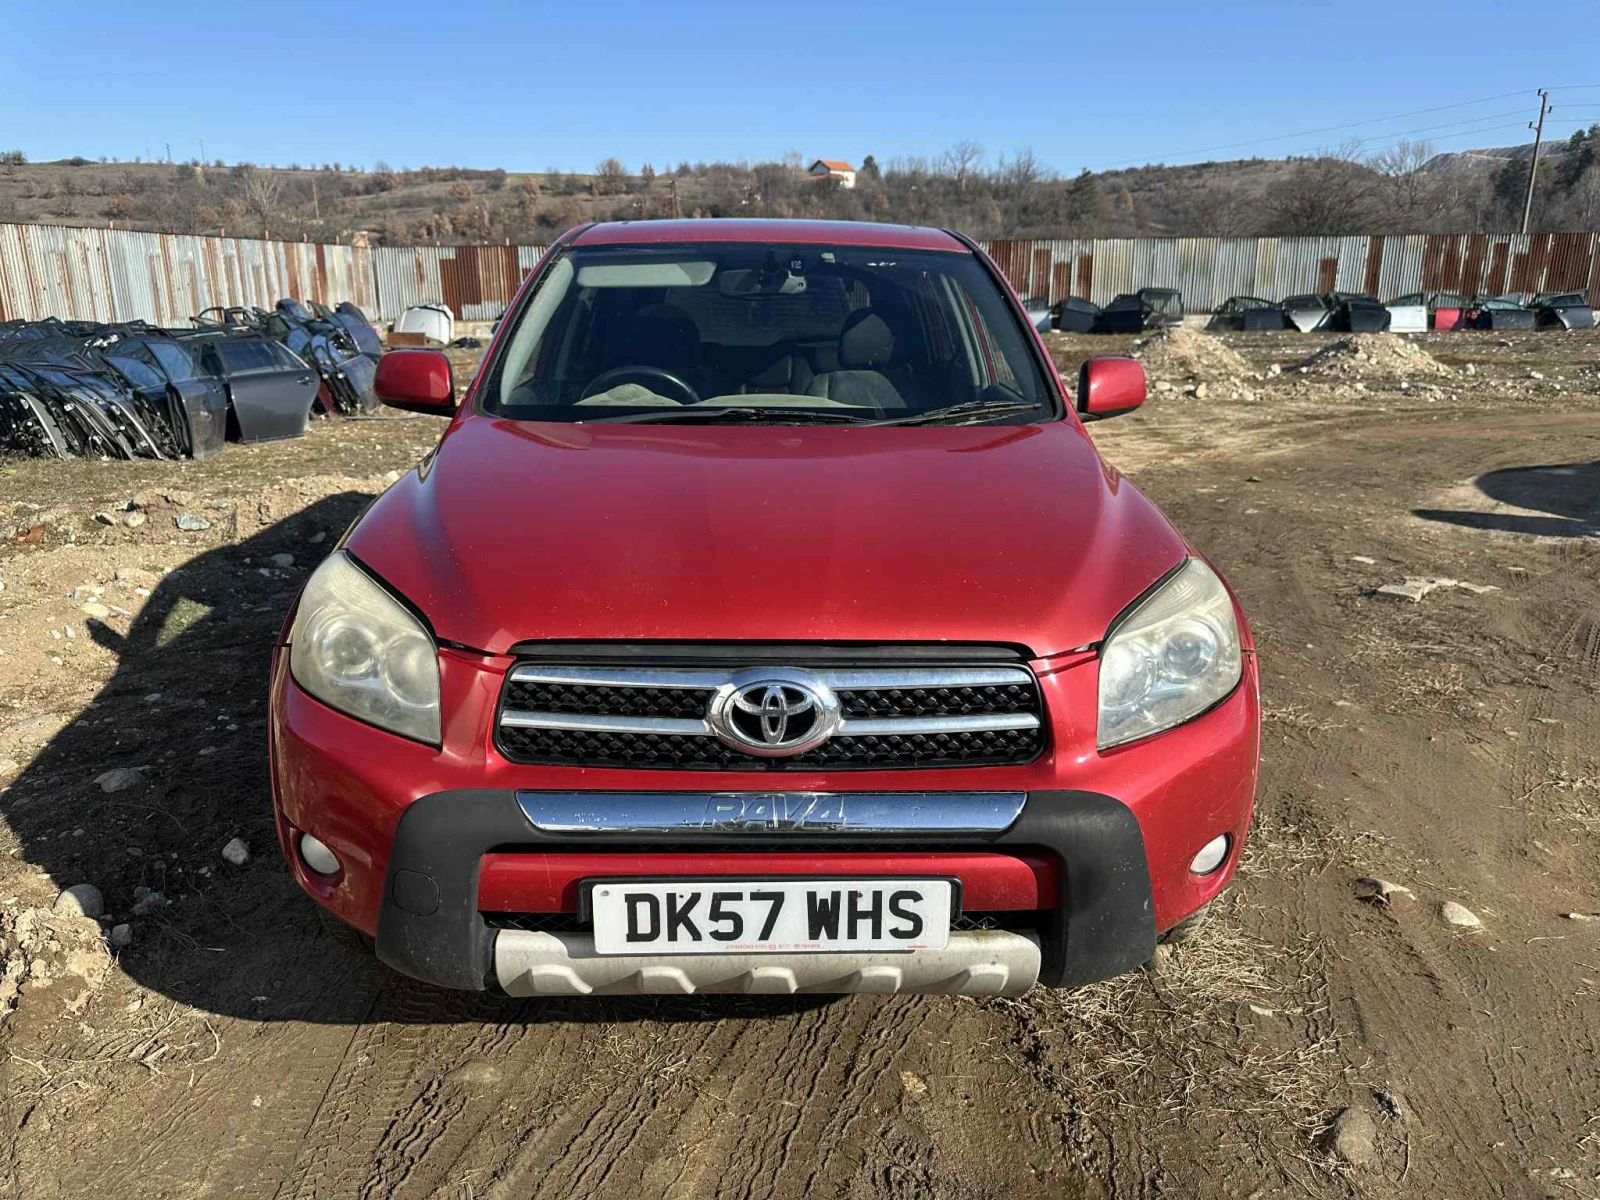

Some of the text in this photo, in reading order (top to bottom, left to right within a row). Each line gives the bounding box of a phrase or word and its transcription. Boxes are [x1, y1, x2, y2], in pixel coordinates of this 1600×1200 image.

[701, 793, 848, 832] RAV4
[624, 890, 924, 943] DK57 WHS
